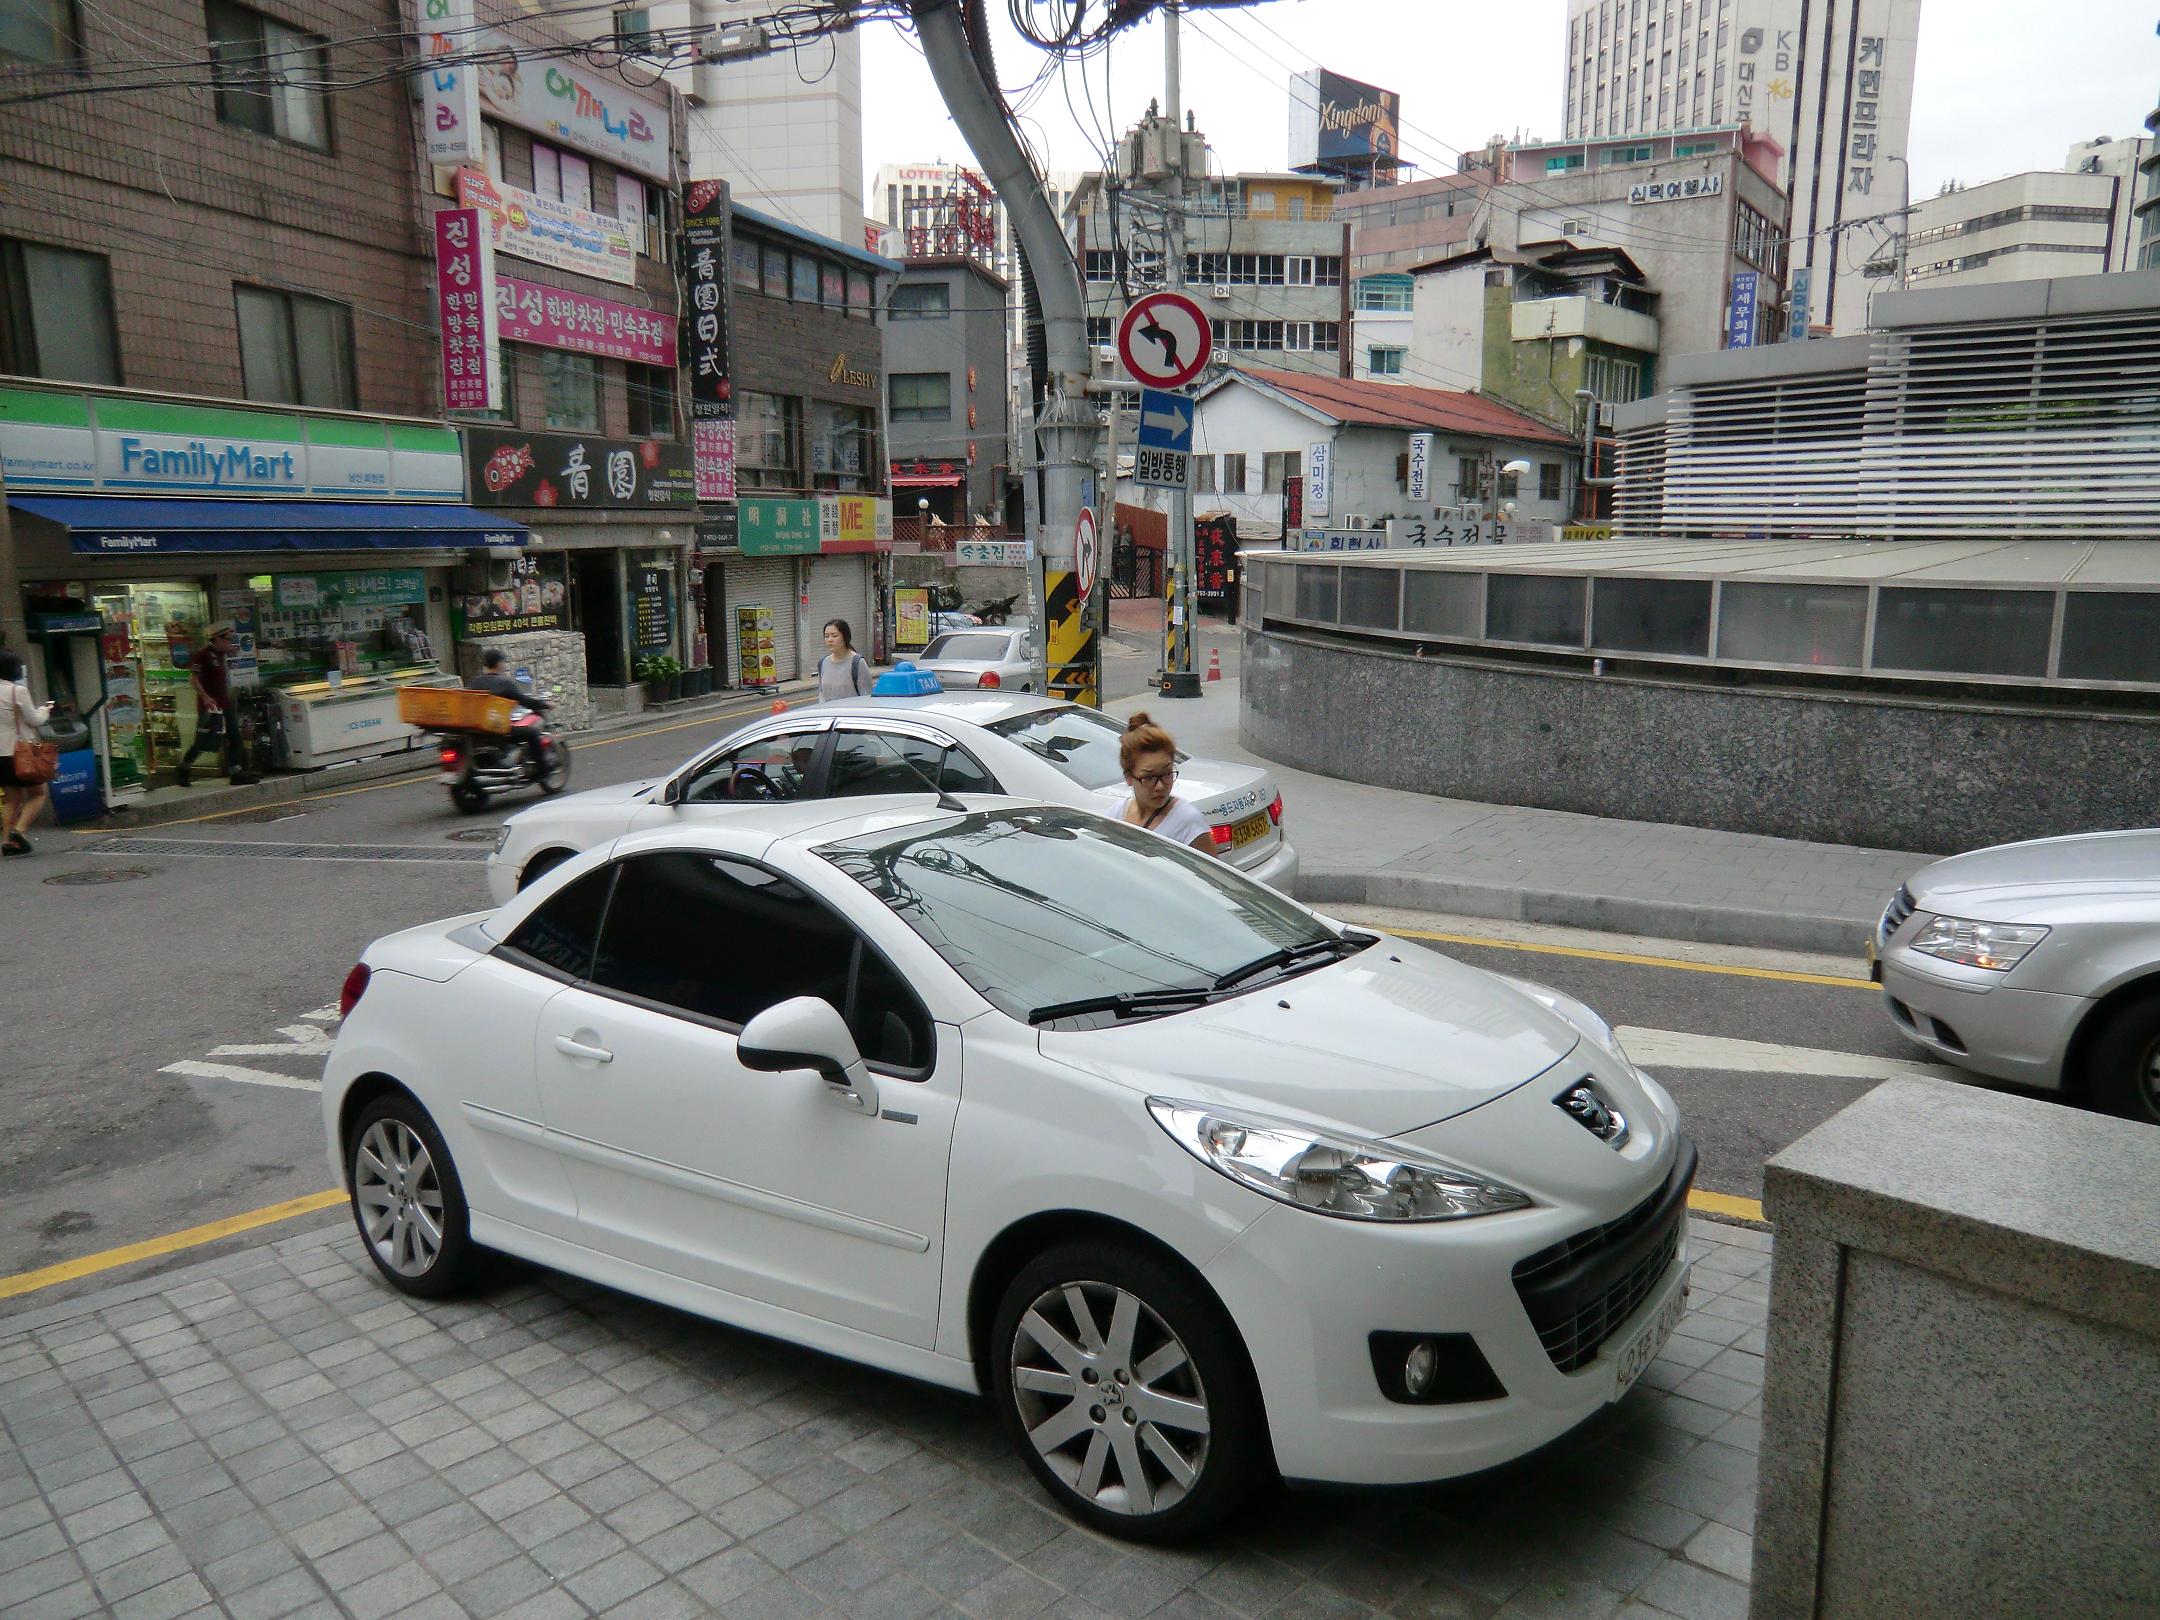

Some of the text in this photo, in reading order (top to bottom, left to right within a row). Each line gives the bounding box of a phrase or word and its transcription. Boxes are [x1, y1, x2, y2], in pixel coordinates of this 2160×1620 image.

[545, 67, 655, 143] 어깨나라
[1319, 97, 1384, 140] Kingdom
[1848, 36, 1884, 195] 커먼프라자
[900, 169, 944, 179] LOTTE
[445, 217, 472, 286] 진성
[464, 291, 482, 376] 민속주점
[121, 437, 294, 484] FamilyMart
[1139, 450, 1187, 483] 일방통행
[1311, 445, 1327, 500] 삼미정
[1411, 439, 1425, 498] 국수전골
[841, 502, 864, 530] ME
[101, 536, 157, 549] FamilyMart
[484, 534, 514, 544] FamilyMart
[960, 545, 1005, 561] 속초집
[917, 677, 940, 691] TAXI
